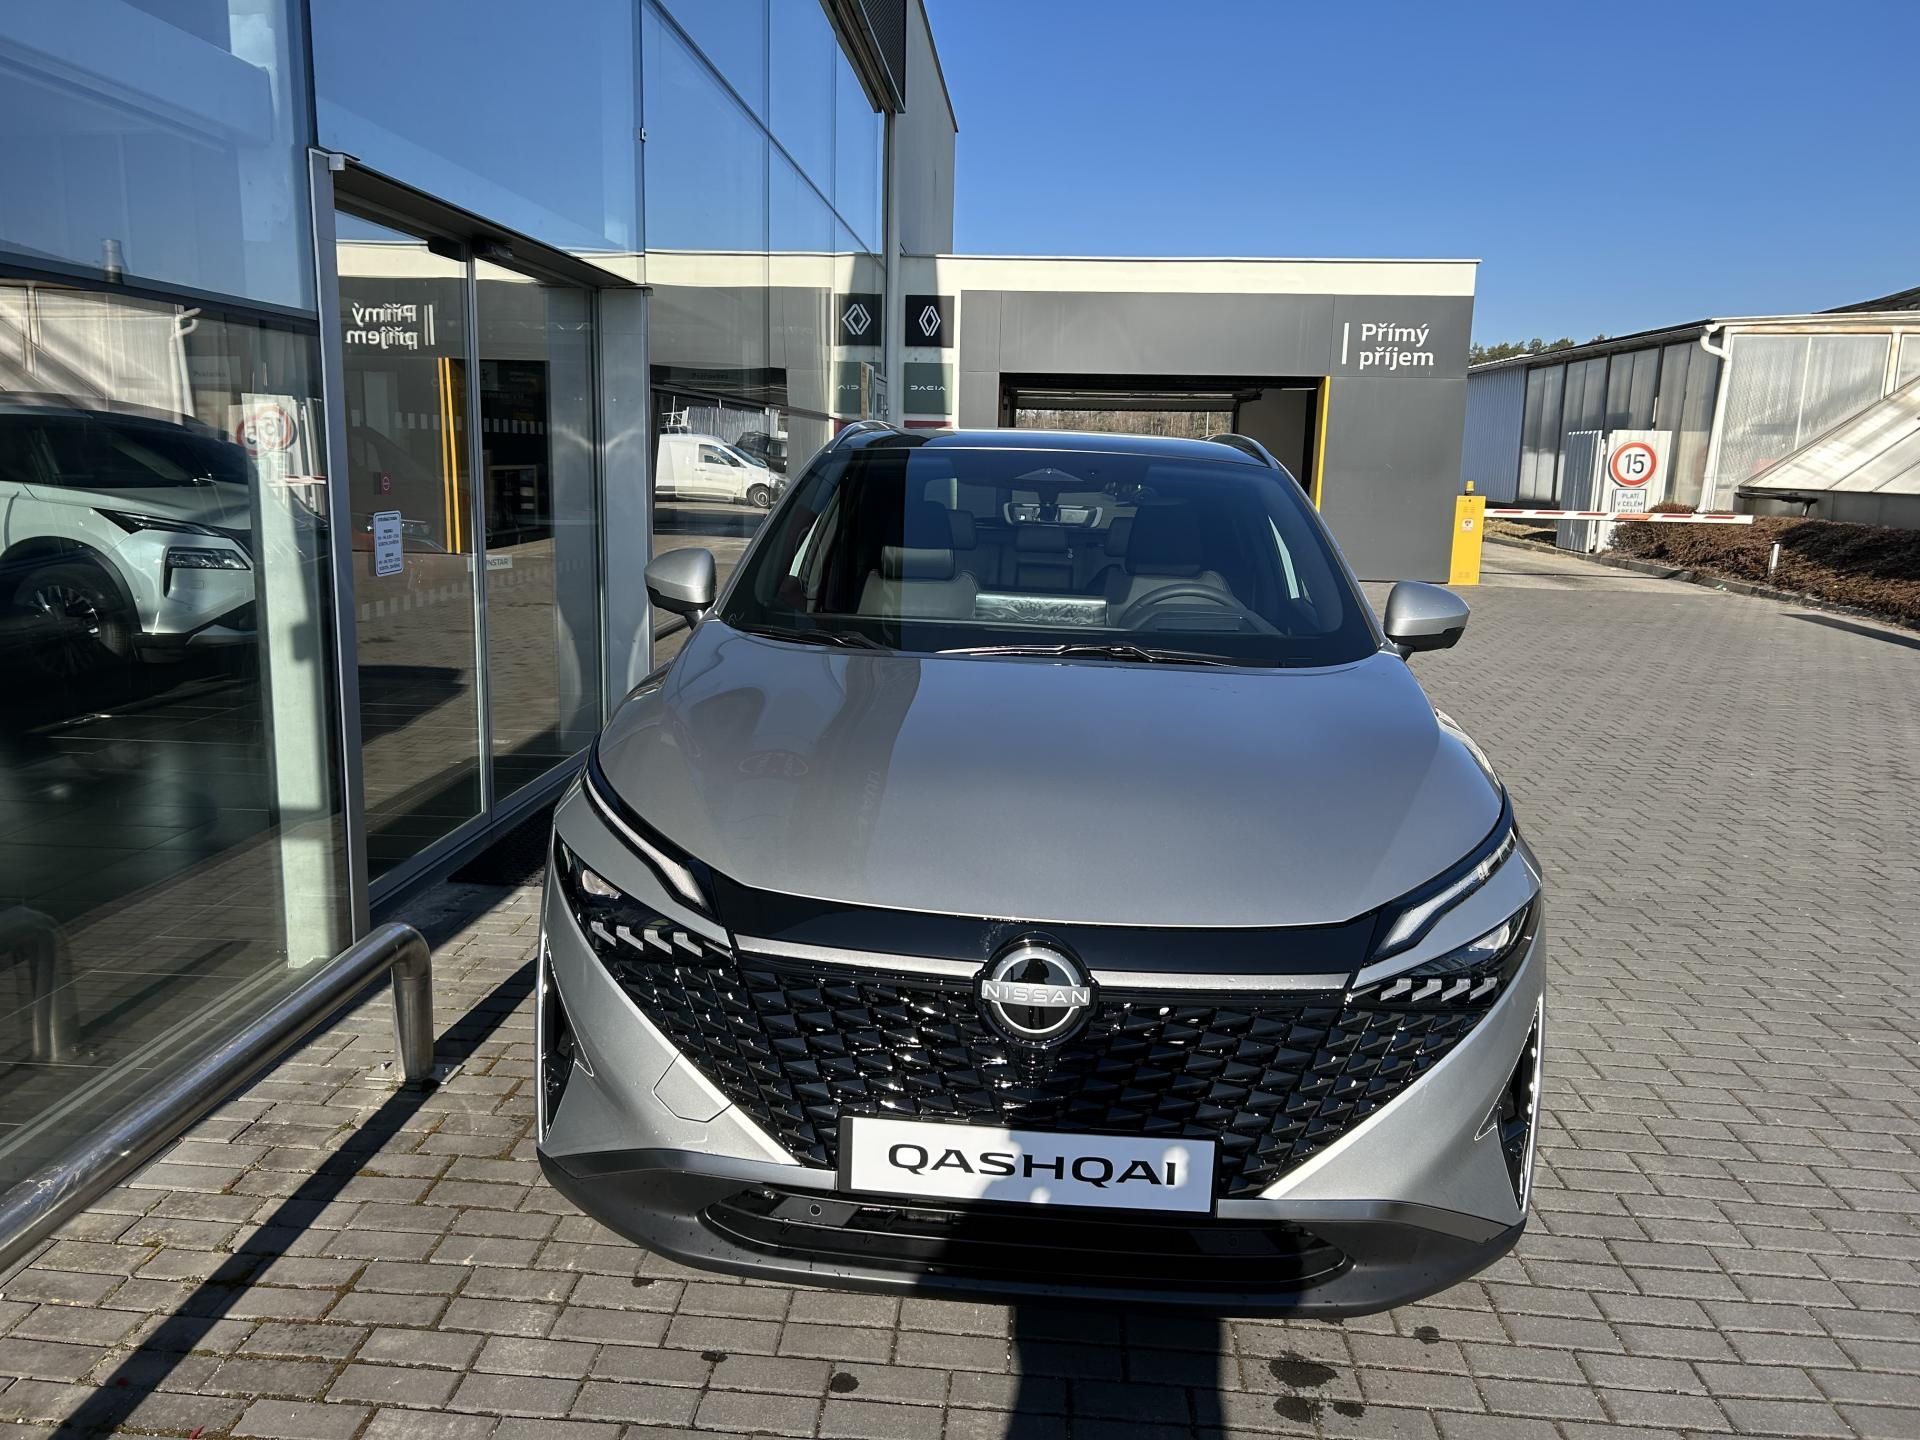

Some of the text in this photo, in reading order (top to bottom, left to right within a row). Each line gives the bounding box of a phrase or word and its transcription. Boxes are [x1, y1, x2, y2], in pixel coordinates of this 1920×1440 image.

[1361, 322, 1430, 347] Přímý
[1359, 346, 1434, 371] příjem
[1625, 453, 1646, 474] 15
[983, 983, 1088, 1004] NISSAN
[888, 1143, 1177, 1189] QASHQAI
